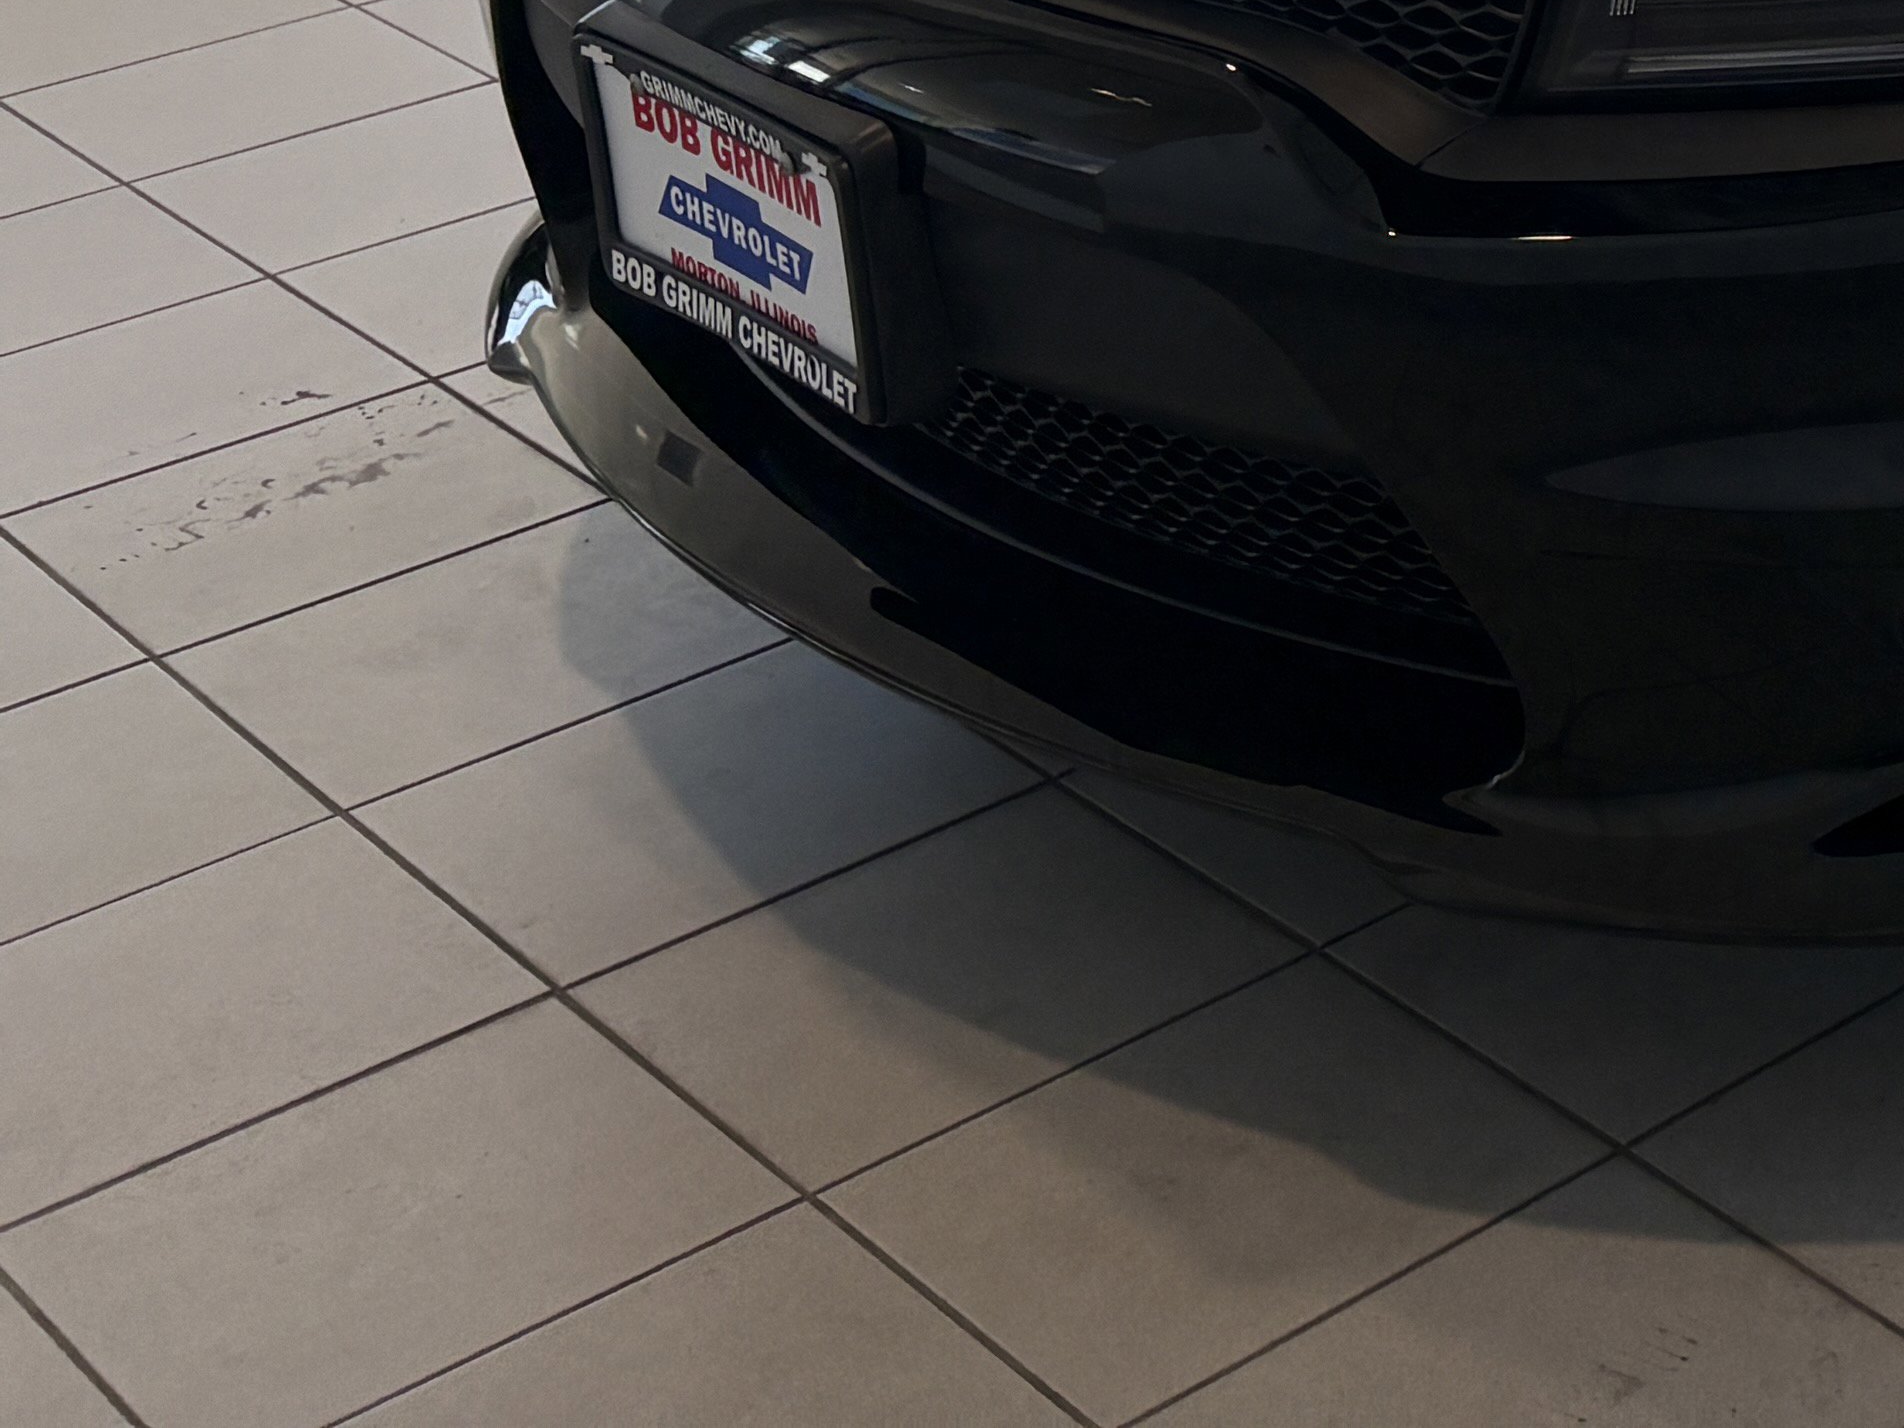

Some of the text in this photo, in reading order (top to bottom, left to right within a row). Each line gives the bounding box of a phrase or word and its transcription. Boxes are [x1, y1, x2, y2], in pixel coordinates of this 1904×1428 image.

[631, 90, 822, 228] BOB GRIMM
[639, 70, 784, 161] GRIMMCHEVY.COM
[669, 185, 801, 282] CHEVROLET
[611, 248, 857, 415] BOB GRIMM CHEVROLET
[749, 289, 819, 344] ILLINOIS
